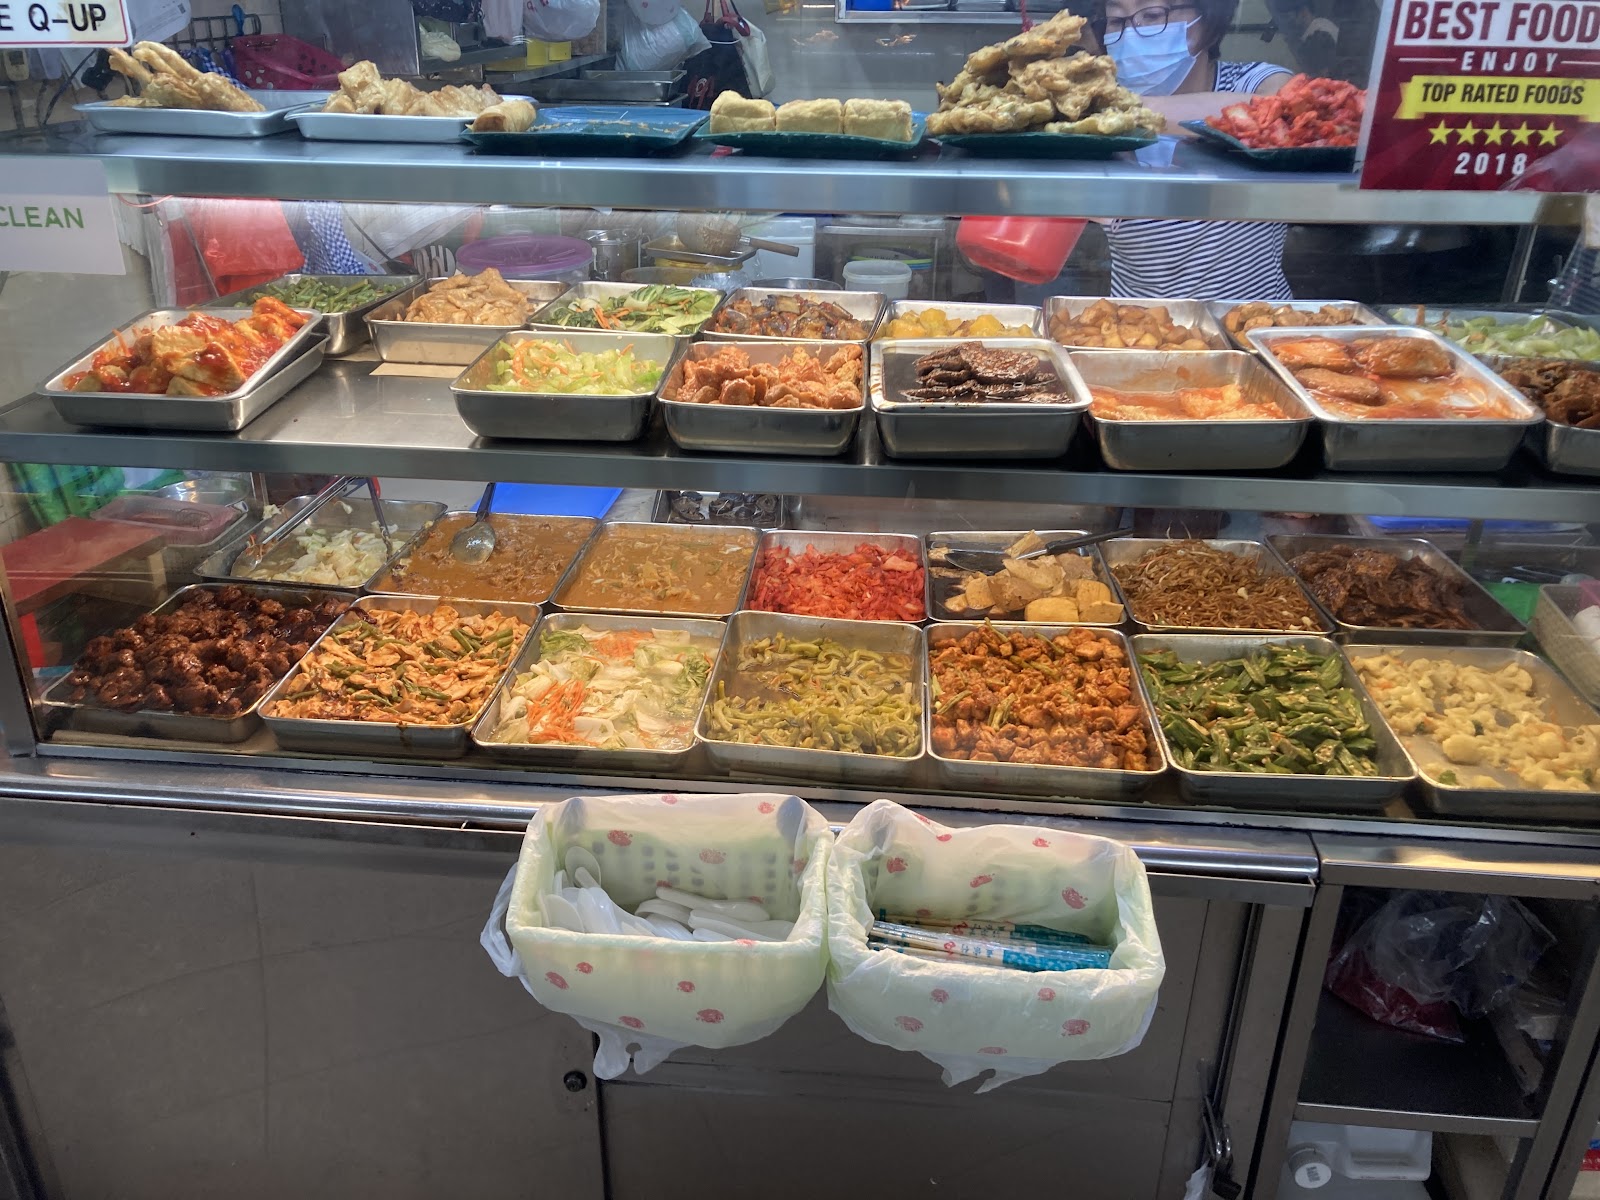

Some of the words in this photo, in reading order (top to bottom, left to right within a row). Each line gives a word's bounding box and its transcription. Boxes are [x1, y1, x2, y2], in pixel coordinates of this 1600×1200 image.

[28, 3, 107, 32] Q-UP
[1403, 0, 1500, 41] BEST
[1506, 3, 1600, 43] FOOD
[1461, 51, 1558, 73] ENJOY
[1421, 83, 1457, 102] TOP
[1460, 83, 1520, 103] RATED
[1523, 84, 1585, 105] FOODS
[1454, 152, 1528, 175] 2018
